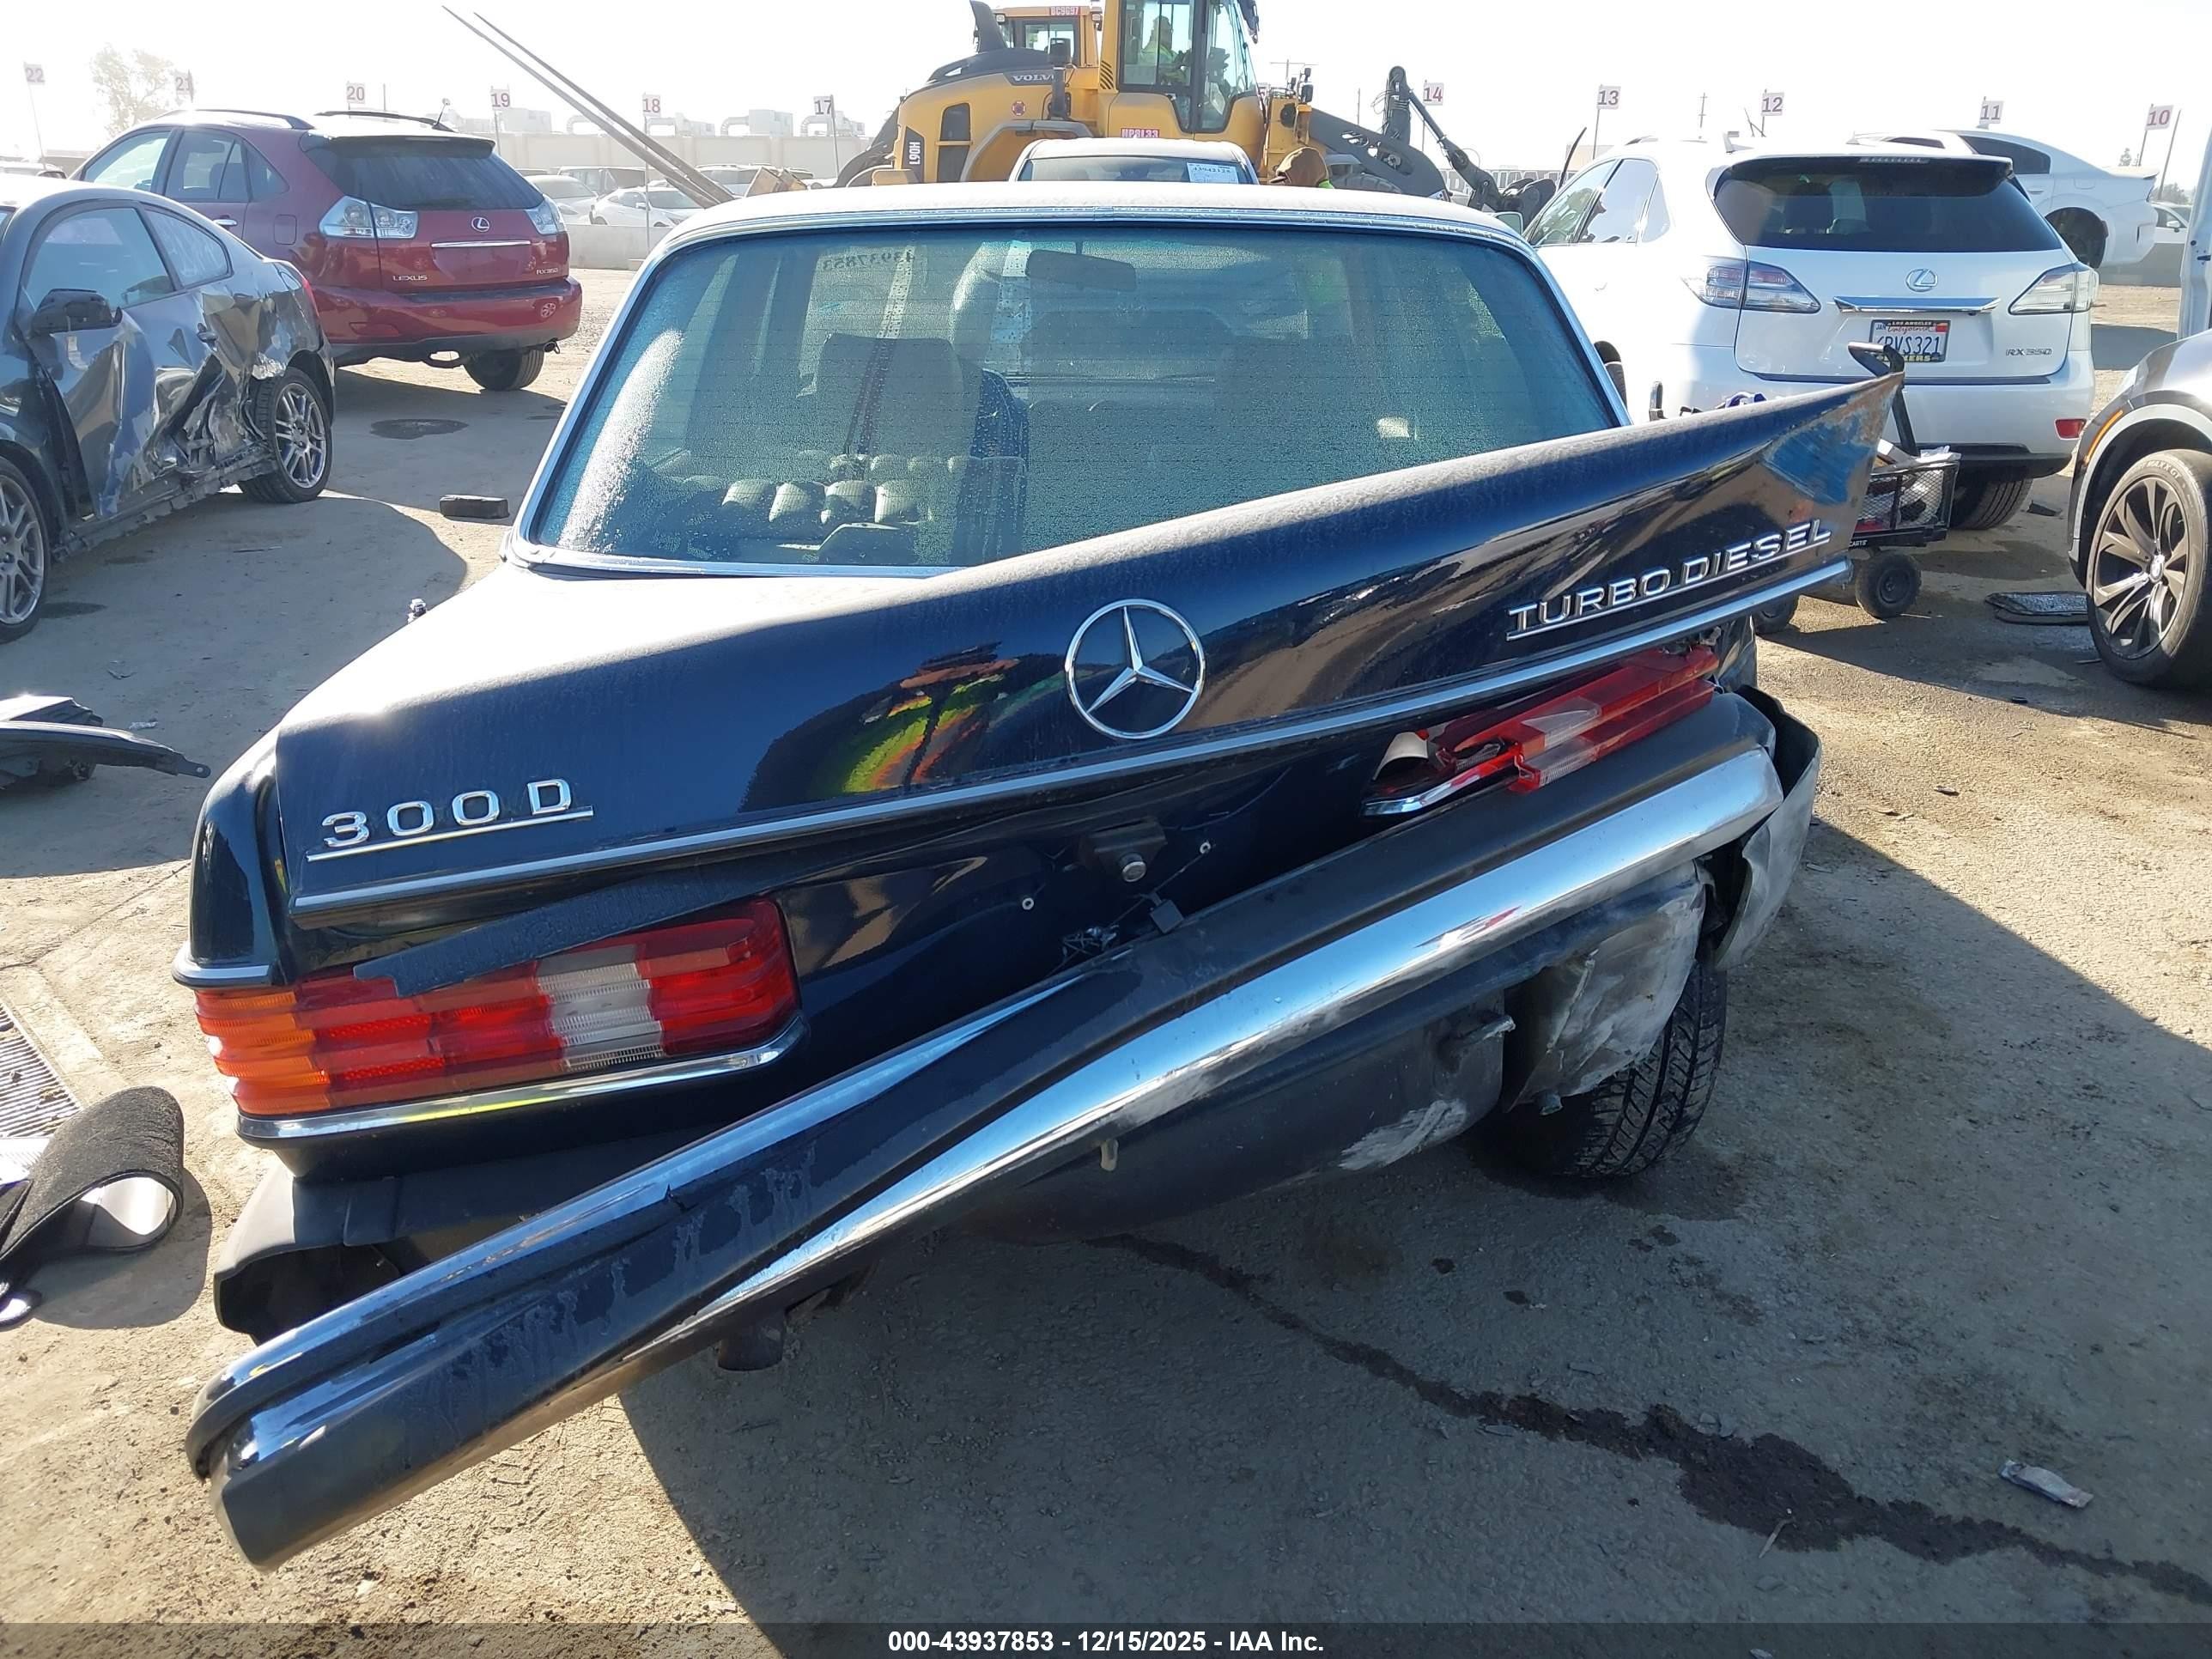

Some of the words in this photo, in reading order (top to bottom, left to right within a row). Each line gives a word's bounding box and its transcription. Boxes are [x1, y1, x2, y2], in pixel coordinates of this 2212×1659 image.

[26, 68, 46, 83] 22
[1012, 74, 1055, 82] VOLV
[346, 85, 365, 101] 20
[491, 93, 511, 108] 19
[1424, 87, 1443, 102] 14
[1597, 89, 1620, 106] 13
[643, 98, 661, 113] 18
[814, 99, 833, 115] 17
[1761, 96, 1784, 112] 12
[1979, 104, 2001, 121] 11
[2147, 109, 2171, 126] 10
[908, 142, 921, 165] L90H
[1887, 325, 1929, 335] California
[1508, 569, 1671, 632] TURBO
[1683, 519, 1832, 585] DIESEL
[321, 789, 501, 848] 300
[527, 779, 573, 817] D
